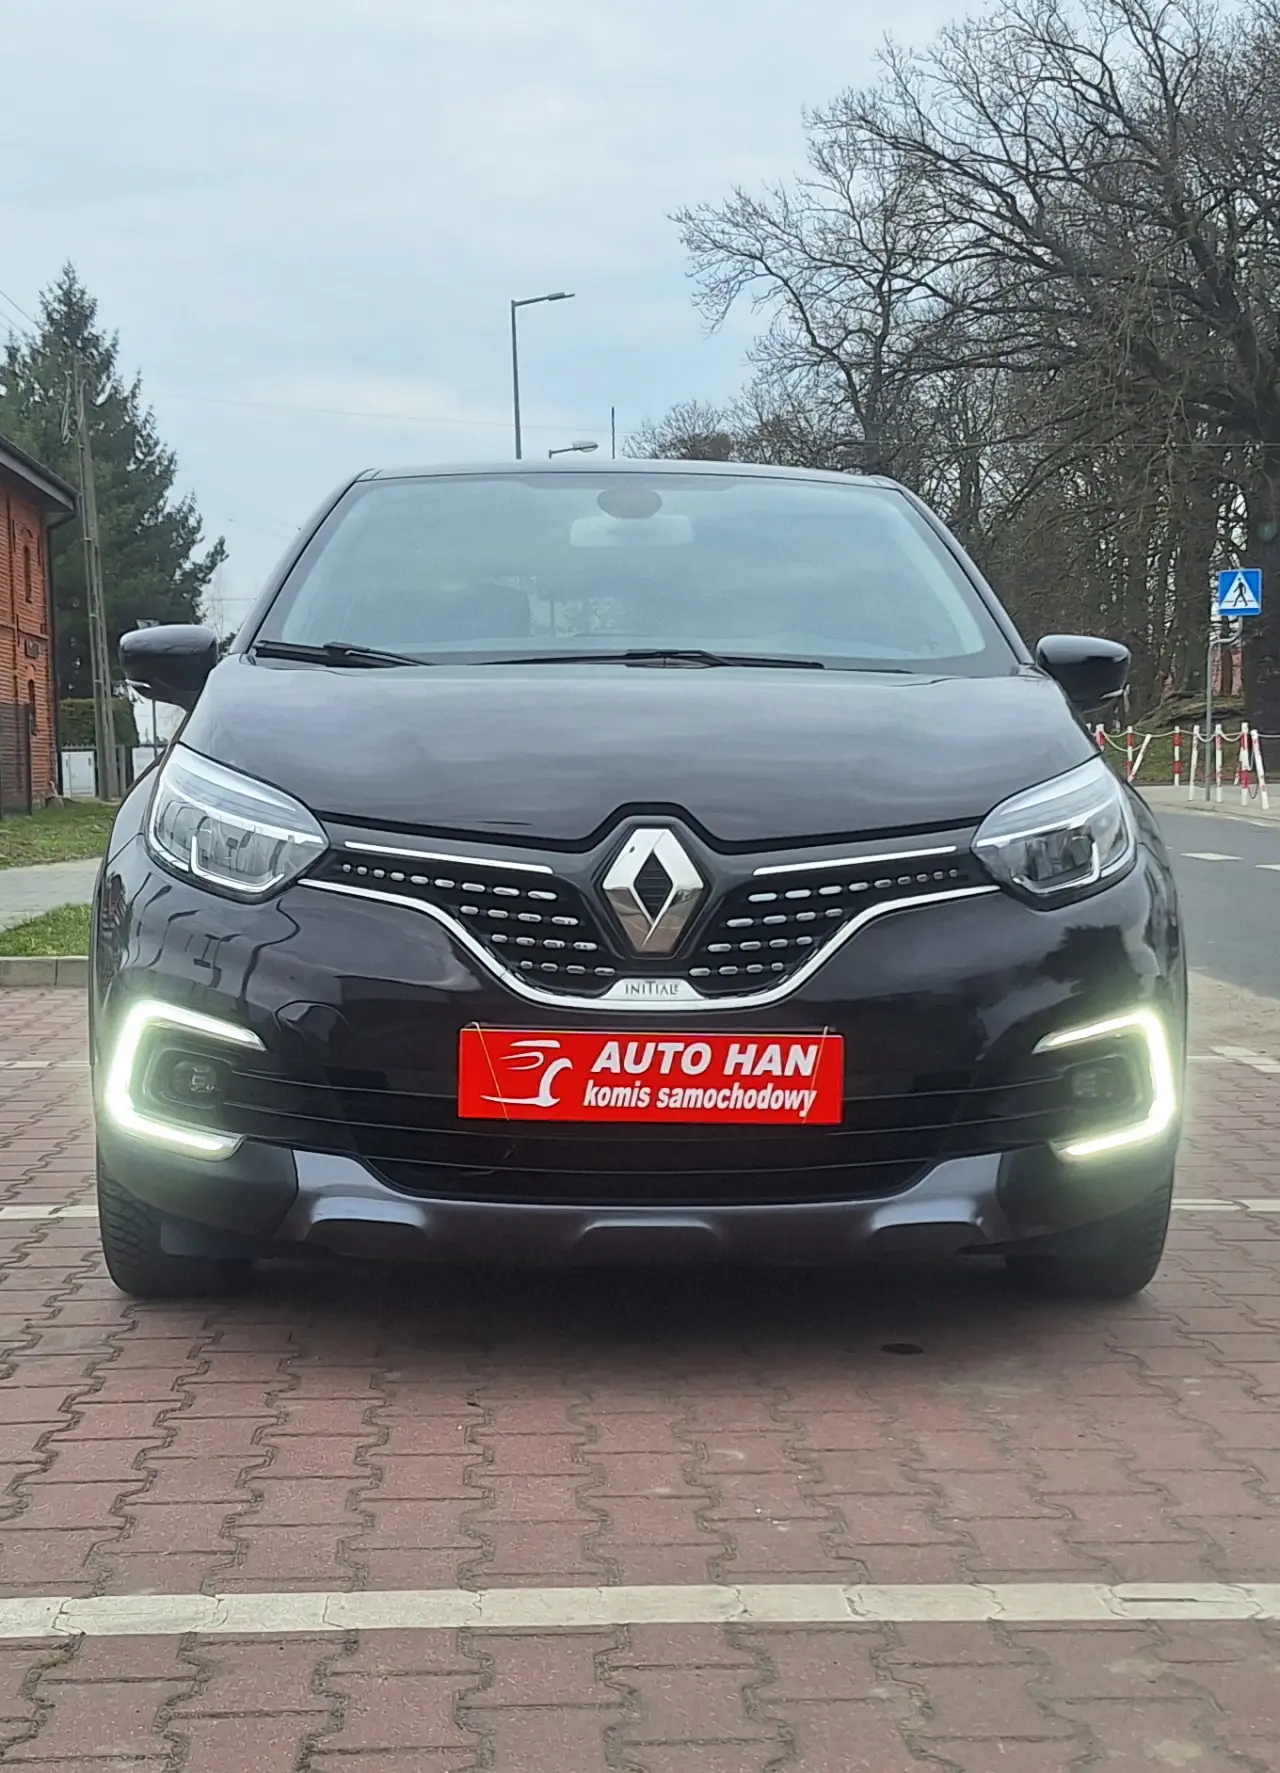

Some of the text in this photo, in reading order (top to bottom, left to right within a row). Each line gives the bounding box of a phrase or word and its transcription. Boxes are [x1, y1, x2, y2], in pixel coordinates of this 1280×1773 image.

[625, 980, 680, 996] INITIALE
[590, 1041, 819, 1077] AUTO HAN
[582, 1079, 817, 1118] komis samochodowy
